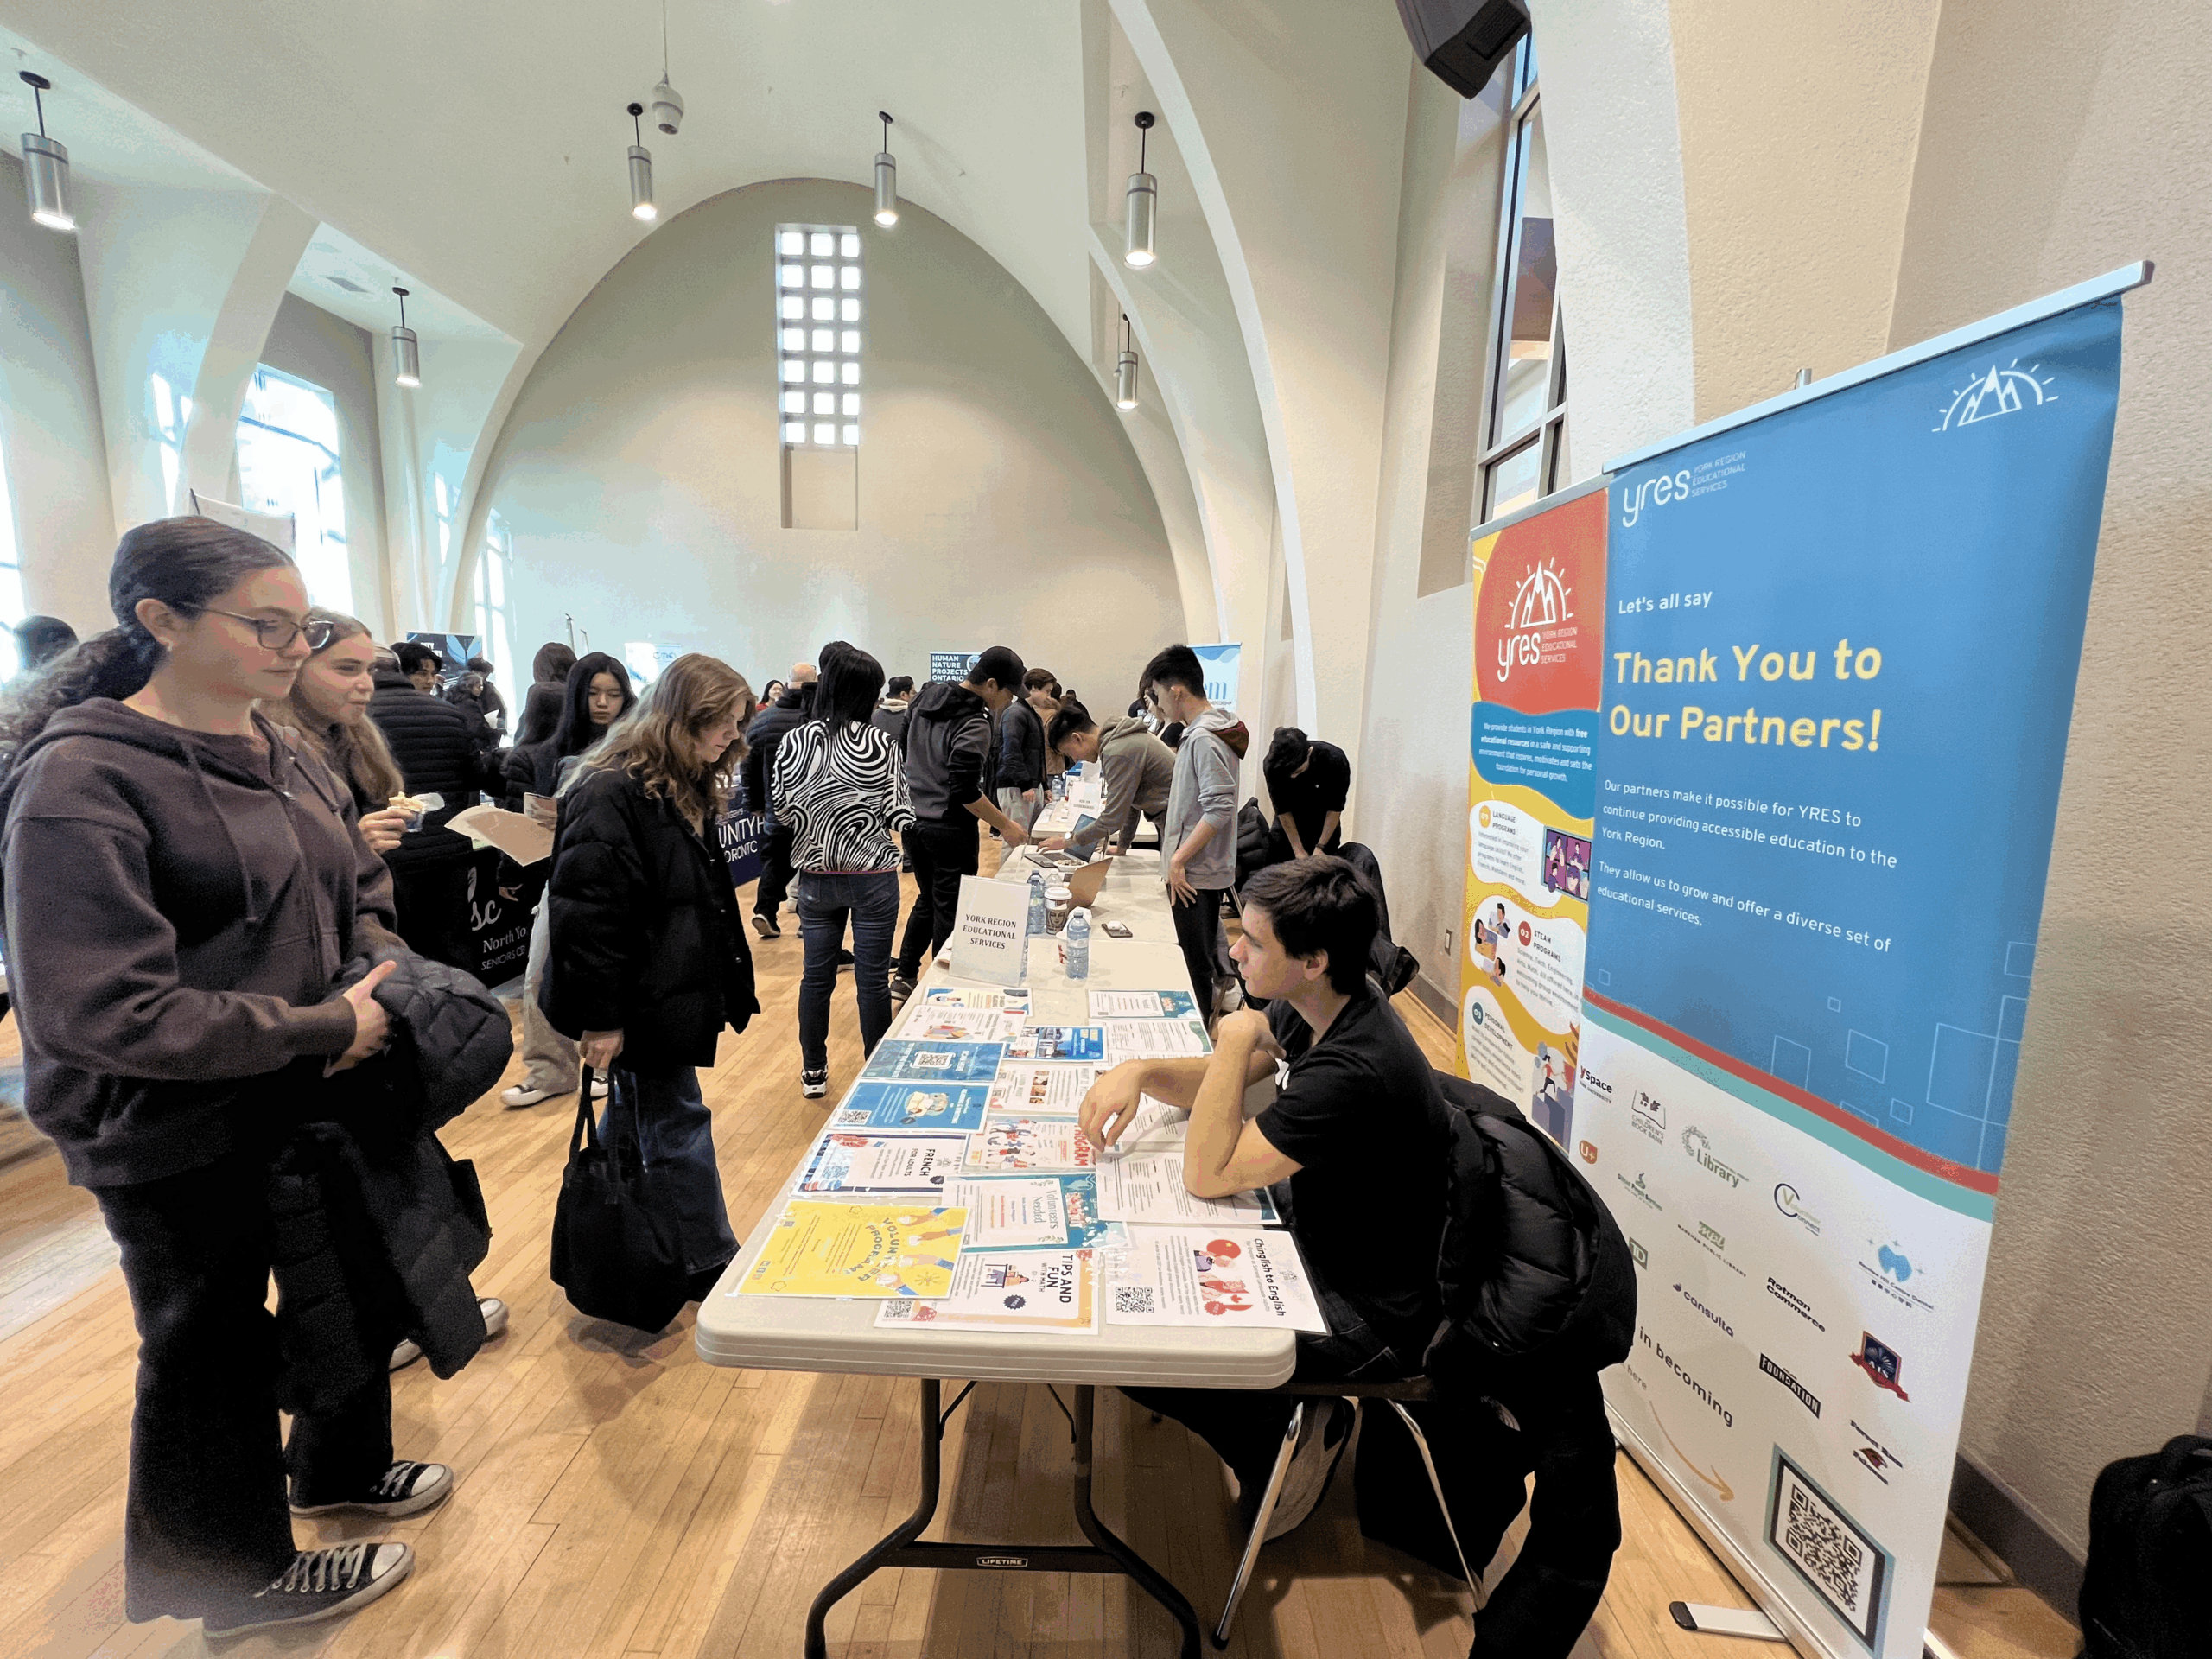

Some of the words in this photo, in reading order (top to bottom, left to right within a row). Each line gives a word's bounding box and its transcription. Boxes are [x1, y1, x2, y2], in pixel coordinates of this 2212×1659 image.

[1692, 462, 1745, 486] EDUCATIONAL
[1694, 461, 1713, 474] YORK
[1715, 450, 1746, 467] REGION
[1623, 469, 1691, 528] yres
[1691, 480, 1727, 497] SERVICES
[1618, 597, 1654, 614] Let's
[1659, 593, 1679, 609] all
[1684, 591, 1713, 608] say
[1497, 632, 1541, 683] yres
[1613, 648, 1718, 683] Thank
[1732, 644, 1815, 682] You
[1834, 639, 1882, 680] to
[1576, 728, 1588, 738] free
[1610, 704, 1670, 738] Our
[1680, 706, 1882, 752] Partners!
[1540, 740, 1551, 750] safe
[1552, 741, 1562, 751] and
[1562, 743, 1591, 756] supporting
[1570, 760, 1581, 769] sets
[1582, 760, 1592, 770] the
[1605, 779, 1621, 791] Our
[1624, 785, 1669, 798] partners
[1673, 791, 1702, 804] make
[1705, 793, 1713, 805] it
[1715, 798, 1769, 814] possible
[1772, 802, 1794, 817] for
[1799, 805, 1840, 823] YRES
[1846, 812, 1861, 827] to
[1492, 810, 1516, 823] LANGUAGE
[1492, 822, 1516, 836] PROGRAMS
[1602, 827, 1622, 841] York
[1624, 831, 1665, 849] Region.
[1603, 805, 1645, 820] continue
[1648, 813, 1699, 832] providing
[1701, 823, 1765, 842] accessible
[1770, 834, 1845, 857] education
[1850, 846, 1865, 861] to
[1871, 849, 1897, 868] the
[1598, 886, 1655, 910] educational
[1656, 902, 1702, 926] services.
[1599, 861, 1621, 878] They
[1623, 869, 1651, 883] allow
[1654, 877, 1666, 888] us
[1669, 879, 1680, 892] to
[1682, 885, 1709, 899] grow
[1712, 893, 1733, 907] and
[1737, 900, 1770, 917] offer
[1774, 910, 1782, 921] a
[1786, 912, 1841, 937] diverse
[1846, 930, 1870, 946] set
[1874, 938, 1891, 952] of
[963, 925, 1016, 940] EDUCATIONAL
[965, 914, 986, 924] YORK
[988, 918, 1017, 929] REGION
[483, 930, 514, 953] North
[970, 938, 1006, 950] SERVICES
[1520, 928, 1529, 939] 02
[1534, 930, 1551, 944] STEAM
[481, 950, 516, 970] SENIORS
[1533, 942, 1561, 963] PROGRAMS
[1580, 1065, 1612, 1094] ySpace
[1631, 1114, 1664, 1140] CHILDREN'S
[1631, 1121, 1648, 1135] BOOK
[1648, 1131, 1663, 1146] BANK
[910, 1148, 918, 1158] FOR
[919, 1148, 936, 1176] FRENCH
[904, 1158, 915, 1176] ADULTS
[1696, 1148, 1739, 1188] Library
[1032, 1197, 1046, 1224] Needed
[1046, 1190, 1059, 1229] Volunteers
[1253, 1238, 1273, 1273] Chinglish
[1677, 1224, 1701, 1244] MARKHAM
[1702, 1243, 1721, 1260] PUBLIC
[1723, 1258, 1746, 1277] LIBRARY
[1046, 1267, 1059, 1288] FUN
[1061, 1255, 1073, 1276] TIPS
[1059, 1279, 1072, 1303] AND
[1265, 1273, 1274, 1284] to
[1268, 1285, 1287, 1317] English
[1768, 1276, 1811, 1313] Rotman
[1683, 1291, 1734, 1338] cansulta
[1766, 1285, 1826, 1332] Commerce
[1627, 1365, 1647, 1390] here
[1639, 1325, 1652, 1348] in
[1656, 1342, 1733, 1427] becoming
[1761, 1357, 1819, 1414] FOUNDATION
